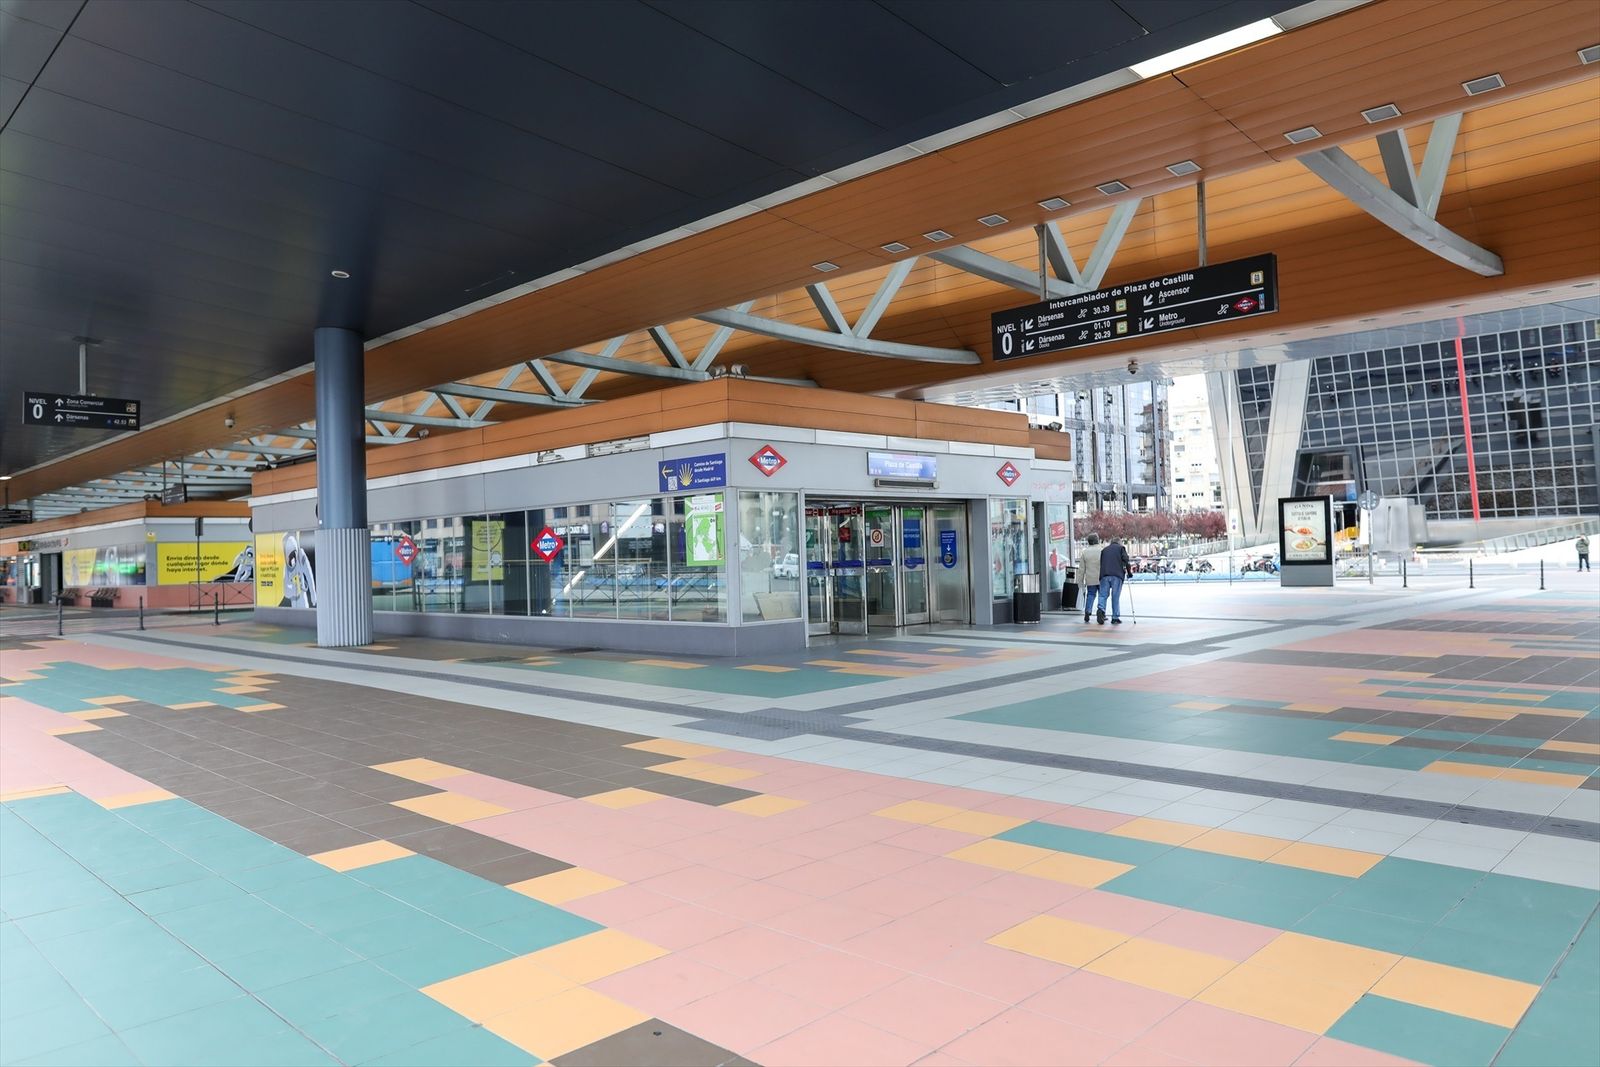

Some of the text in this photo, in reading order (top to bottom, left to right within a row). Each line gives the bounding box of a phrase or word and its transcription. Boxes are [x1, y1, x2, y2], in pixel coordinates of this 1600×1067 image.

[1049, 272, 1195, 310] Intercambiador de Plaza de Castilla
[1158, 285, 1191, 299] Ascensor
[1093, 304, 1110, 315] 30.39
[1037, 312, 1065, 323] Dársenas
[1158, 311, 1178, 321] Metro
[1093, 320, 1111, 330] 01.10
[1158, 317, 1186, 327] Underground
[996, 323, 1017, 334] NIVEL
[1038, 333, 1065, 344] Dársenas
[1094, 330, 1111, 341] 20.29
[1001, 332, 1013, 355] 0
[29, 397, 47, 405] NIVEL
[32, 404, 43, 419] 0
[760, 456, 778, 465] Metro
[539, 540, 556, 550] Metro
